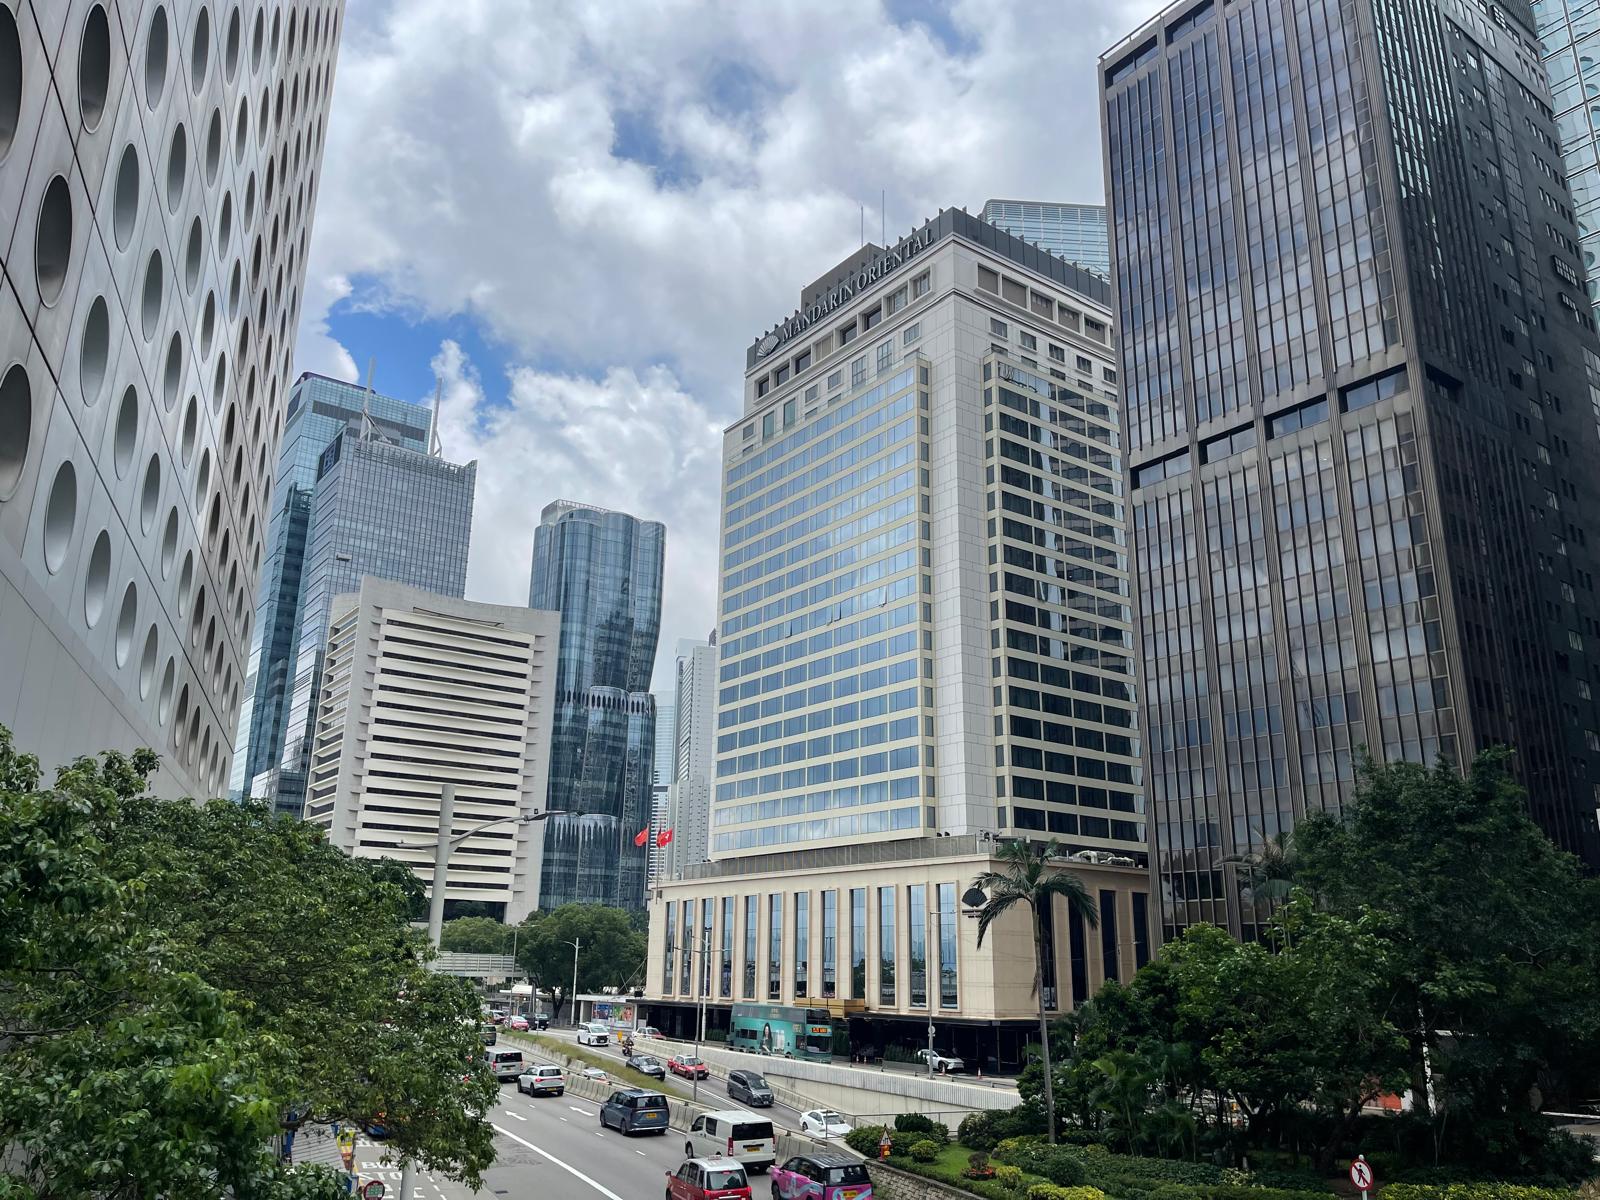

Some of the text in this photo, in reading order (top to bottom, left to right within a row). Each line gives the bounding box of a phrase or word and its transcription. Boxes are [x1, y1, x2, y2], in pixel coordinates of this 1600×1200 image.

[783, 228, 934, 342] MANDARIN ORIENTAL
[356, 1171, 403, 1181] STO
